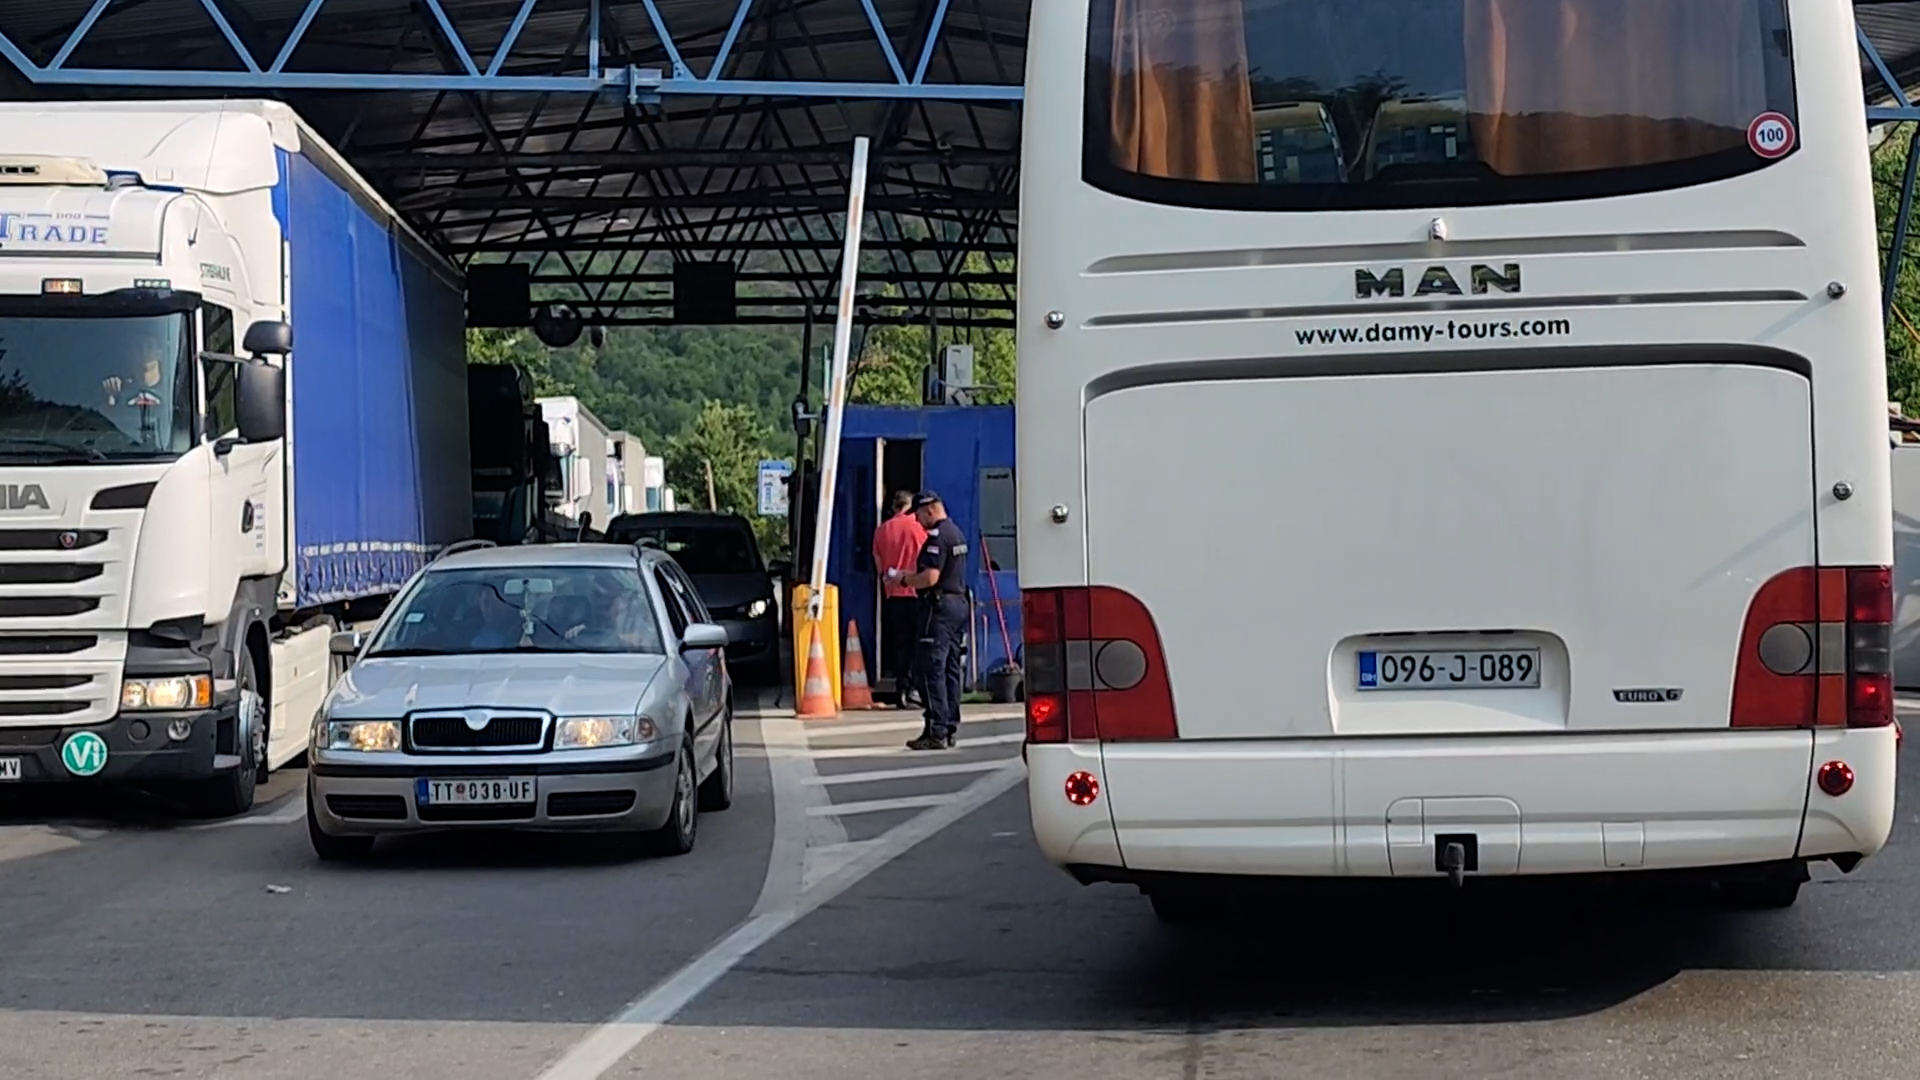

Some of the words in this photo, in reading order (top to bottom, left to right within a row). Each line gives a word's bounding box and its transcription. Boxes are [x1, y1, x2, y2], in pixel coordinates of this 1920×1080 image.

[1758, 127, 1784, 143] 100
[1355, 263, 1521, 298] MAN
[1295, 318, 1571, 345] www.damy-tours.com
[1381, 654, 1533, 682] 096-J-089
[1618, 691, 1659, 701] EURO
[69, 740, 100, 768] VI
[432, 783, 453, 801] TT
